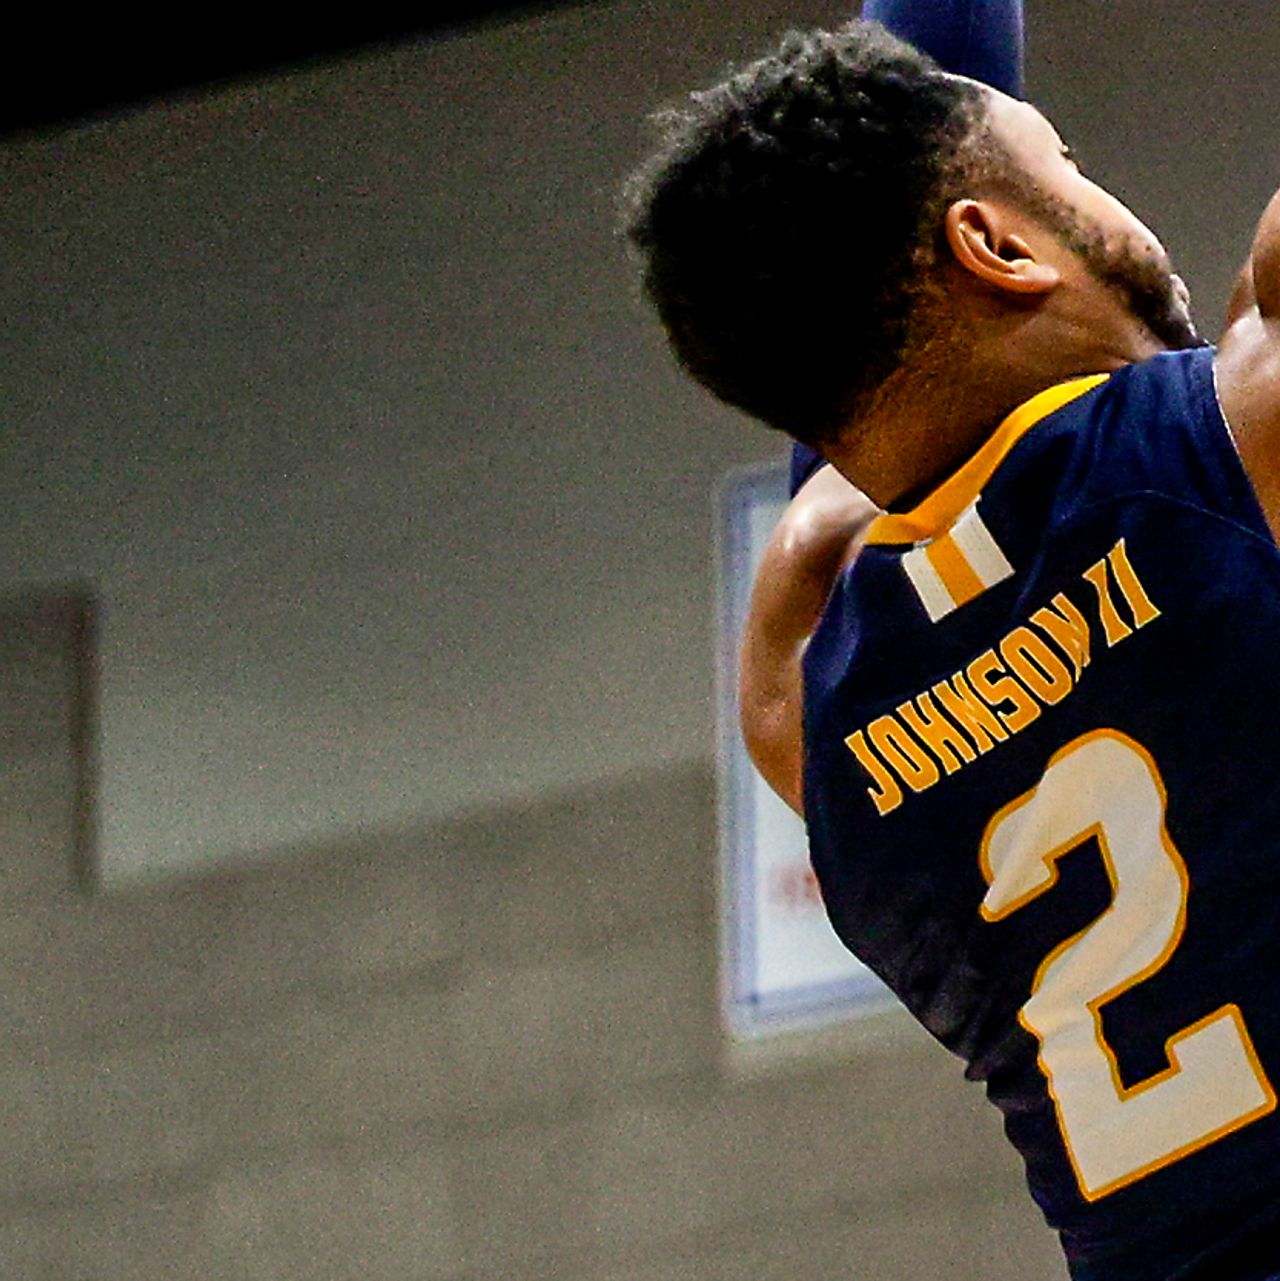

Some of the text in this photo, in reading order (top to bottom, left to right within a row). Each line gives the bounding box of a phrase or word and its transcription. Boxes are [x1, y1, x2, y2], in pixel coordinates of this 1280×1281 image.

[844, 537, 1162, 816] JOHNSON II
[977, 727, 1278, 1202] 2
